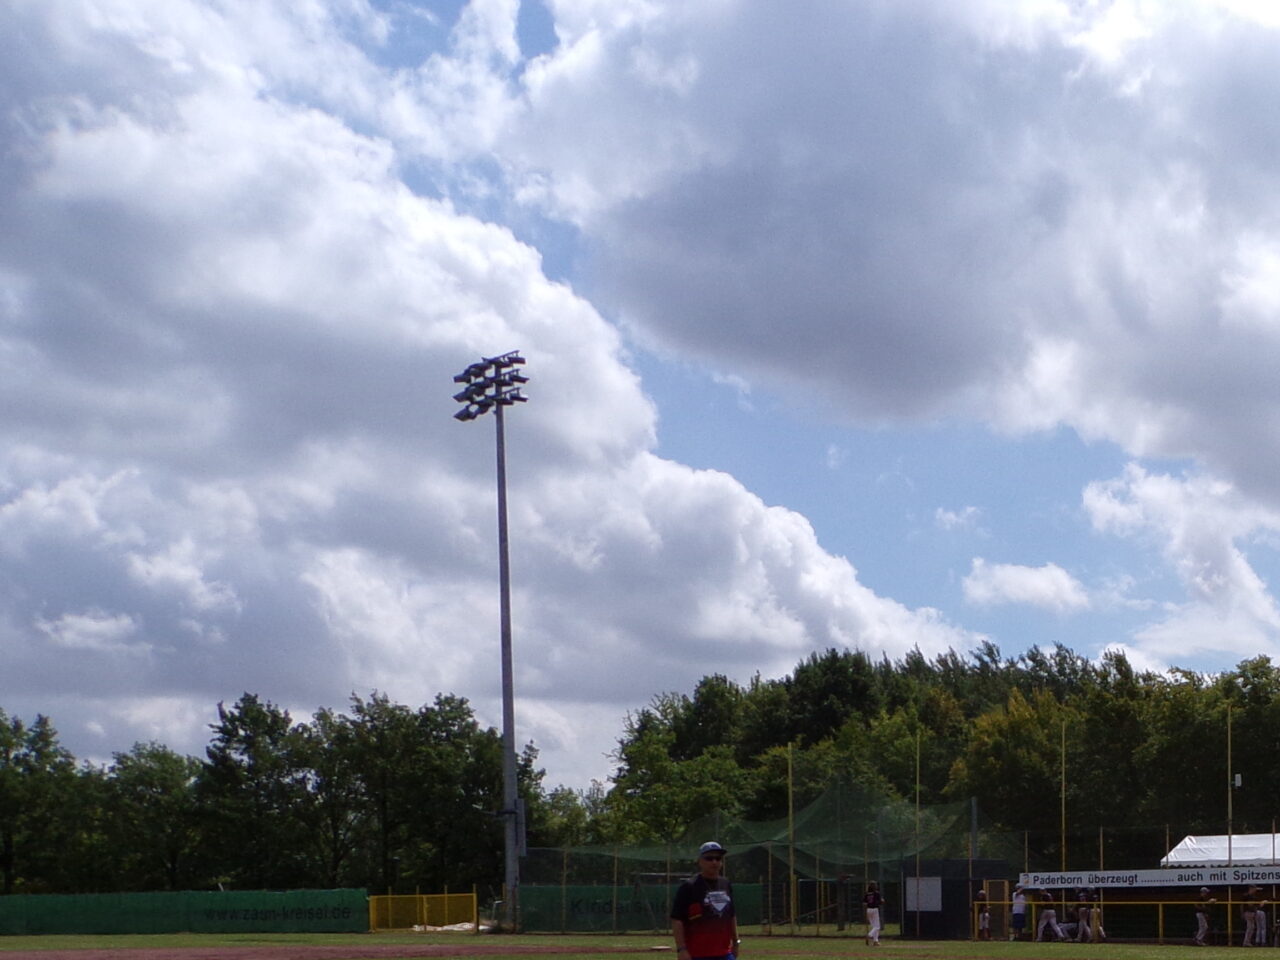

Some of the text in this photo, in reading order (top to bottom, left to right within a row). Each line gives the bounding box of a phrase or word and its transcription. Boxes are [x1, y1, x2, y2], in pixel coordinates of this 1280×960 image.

[1033, 875, 1083, 885] Paderborn
[1088, 873, 1138, 885] überzeugt
[1177, 870, 1203, 881] auch
[1210, 870, 1227, 881] mit
